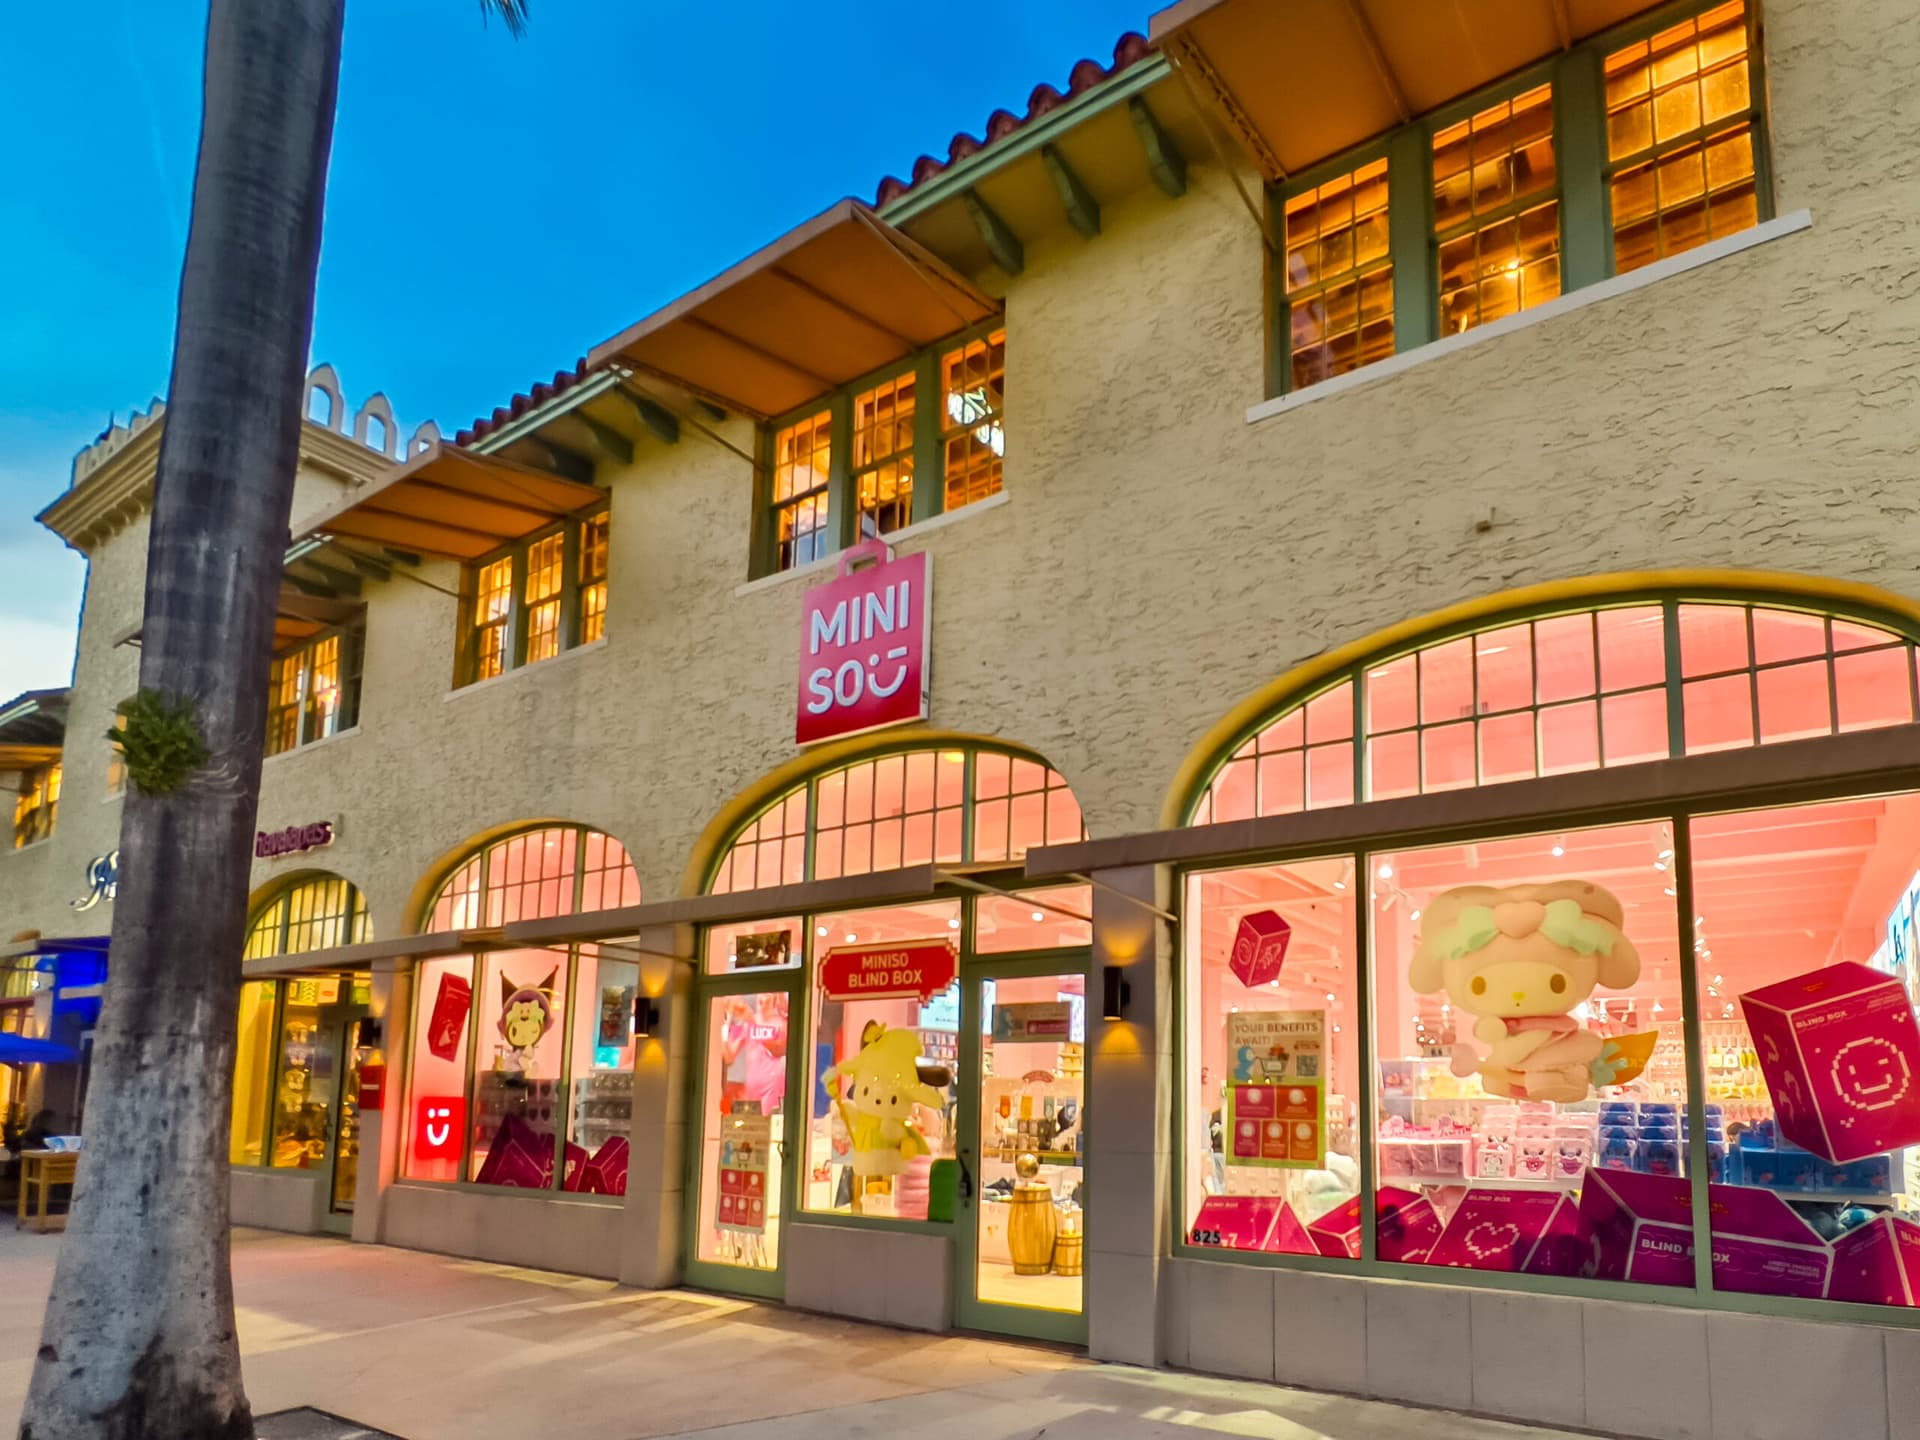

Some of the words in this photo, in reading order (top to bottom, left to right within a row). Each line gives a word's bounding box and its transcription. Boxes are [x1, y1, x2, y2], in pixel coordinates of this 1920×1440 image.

[810, 580, 910, 655] MINI
[862, 952, 909, 970] MINISO
[848, 971, 889, 988] BLIND
[892, 968, 922, 985] BOX
[1234, 1023, 1264, 1034] YOUR
[1267, 1021, 1319, 1033] BENEFITS
[1795, 1016, 1825, 1029] BLIND
[1826, 1010, 1848, 1020] BOX
[1193, 1228, 1221, 1245] 825
[1641, 1239, 1683, 1254] BLIND
